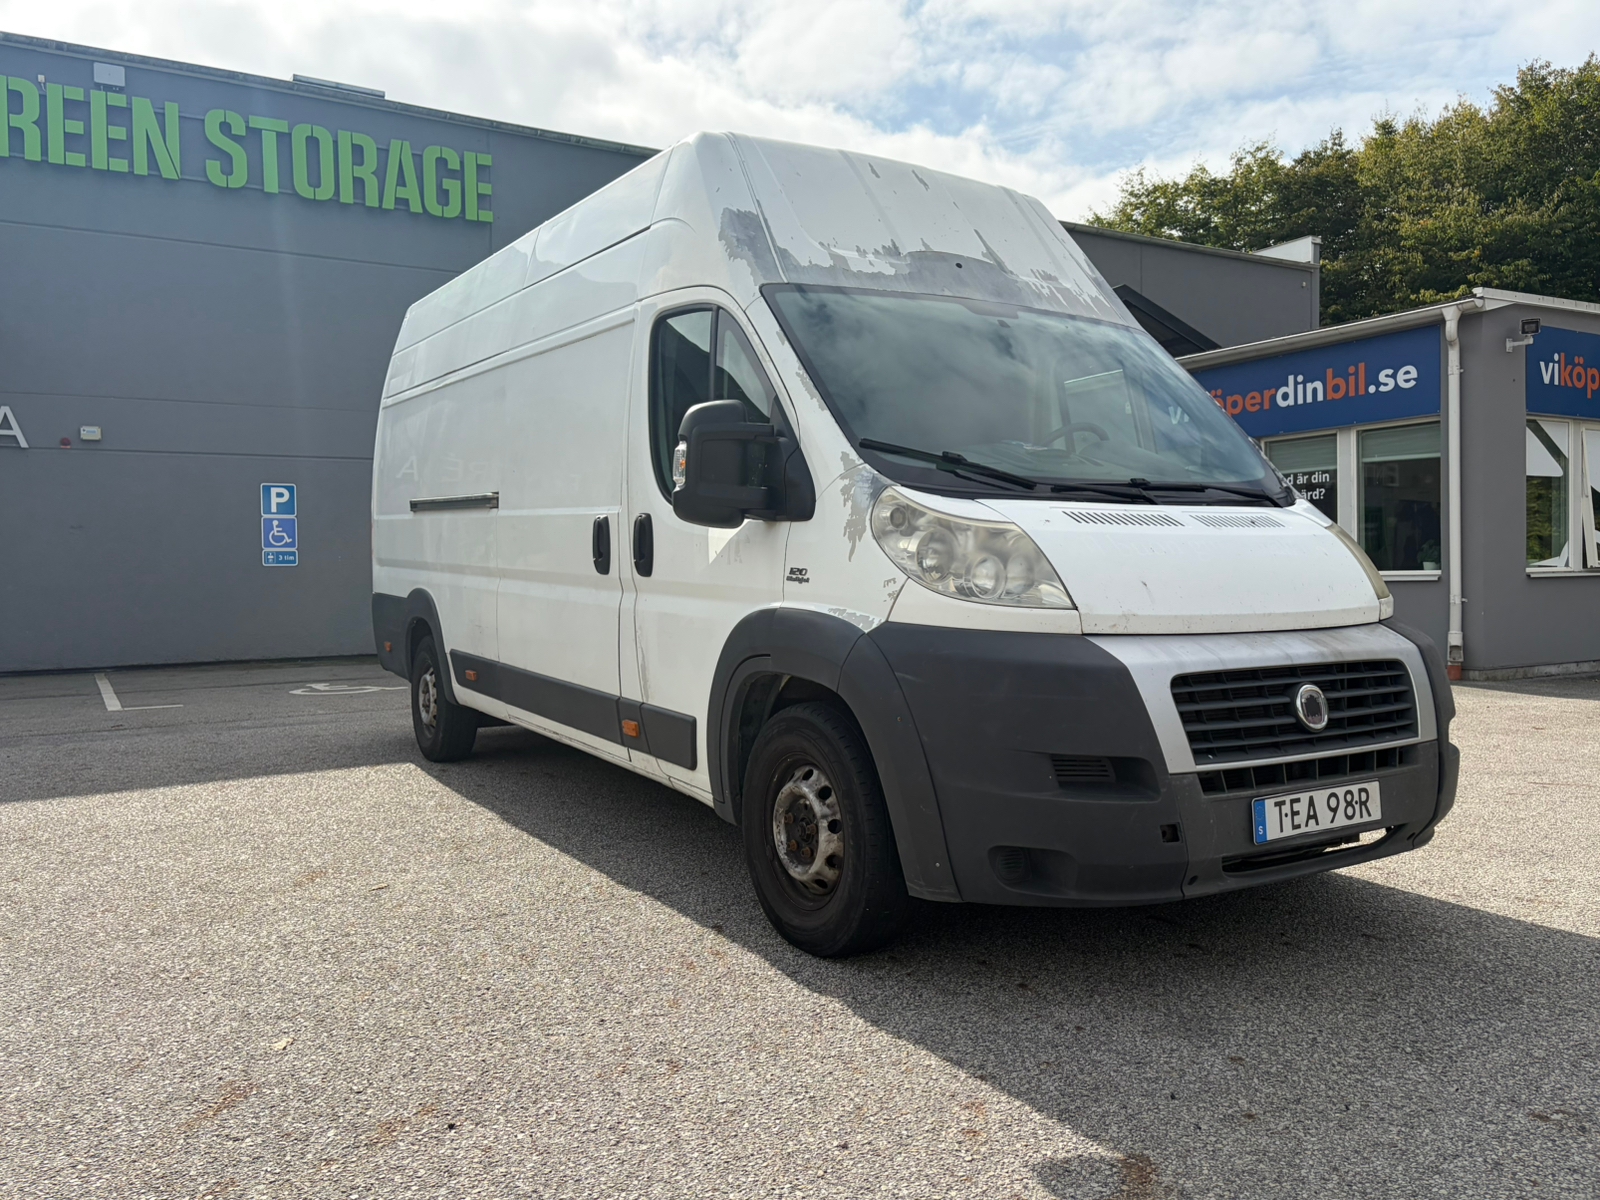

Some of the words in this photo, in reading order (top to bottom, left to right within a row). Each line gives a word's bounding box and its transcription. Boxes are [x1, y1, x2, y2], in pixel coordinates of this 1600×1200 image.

[204, 109, 494, 223] STORAGE
[1296, 473, 1309, 485] är
[1311, 471, 1330, 483] din
[1300, 488, 1326, 500] ärd?
[1273, 795, 1320, 833] TEA
[1326, 787, 1372, 824] 98R
